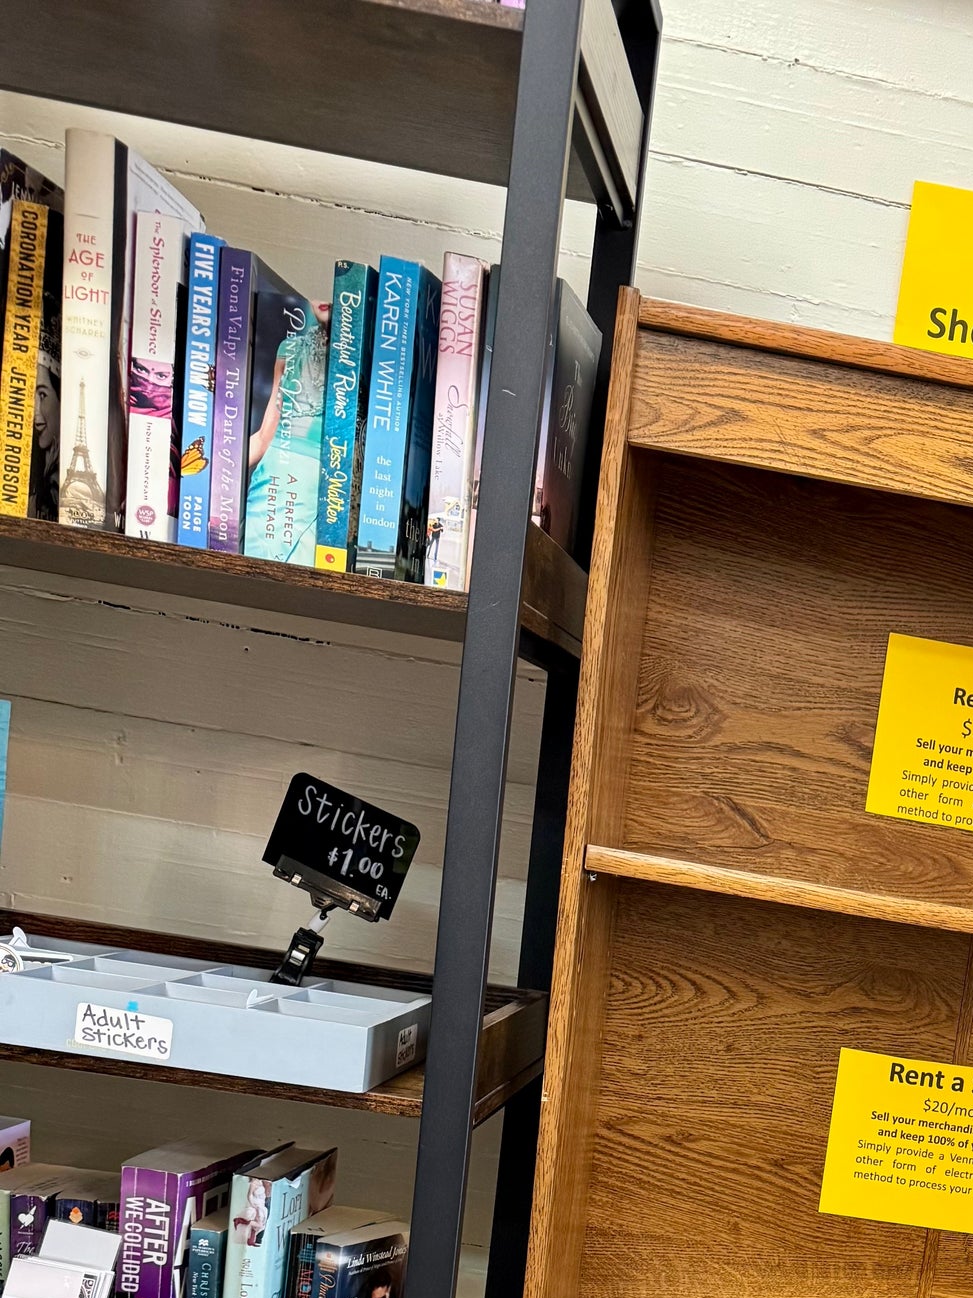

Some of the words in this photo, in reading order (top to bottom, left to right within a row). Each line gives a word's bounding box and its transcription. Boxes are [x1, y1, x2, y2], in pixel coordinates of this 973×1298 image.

[75, 233, 97, 246] THE
[15, 209, 39, 309] CORONATION
[68, 250, 105, 269] AGE
[80, 271, 94, 282] OF
[194, 241, 215, 281] FIVE
[64, 285, 110, 306] LIGHT
[191, 283, 212, 338] YEARS
[379, 271, 403, 351] KAREN
[12, 309, 32, 354] YEAR
[334, 288, 362, 368] Beautiful
[438, 280, 459, 355] WIGGS
[456, 279, 479, 358] SUSAN
[190, 339, 211, 387] FROM
[8, 366, 28, 438] JENNIFER
[187, 388, 208, 427] NOW
[334, 369, 357, 420] Ruins
[372, 359, 396, 432] WHITE
[327, 434, 348, 473] Jess
[376, 454, 392, 468] the
[0, 441, 21, 504] ROBSON
[374, 469, 392, 483] last
[325, 470, 348, 525] Walter
[369, 484, 395, 501] night
[375, 501, 386, 513] in
[182, 494, 193, 531] TOON
[192, 495, 203, 533] PAIGE
[362, 514, 396, 530] london
[914, 736, 936, 750] Sell
[937, 743, 964, 755] your
[900, 768, 938, 788] Simply
[922, 757, 944, 769] and
[945, 759, 973, 776] keep
[896, 804, 939, 820] method
[940, 811, 953, 822] to
[898, 787, 929, 801] other
[937, 791, 963, 807] form
[296, 784, 407, 860] Stickers
[326, 847, 385, 881] $1.00
[375, 883, 393, 902] EA.
[81, 1003, 147, 1029] Adult
[888, 1061, 945, 1090] Rent
[950, 1075, 965, 1093] a
[124, 1196, 144, 1220] WE
[142, 1197, 171, 1268] AFTER
[121, 1221, 143, 1293] COLLIDED
